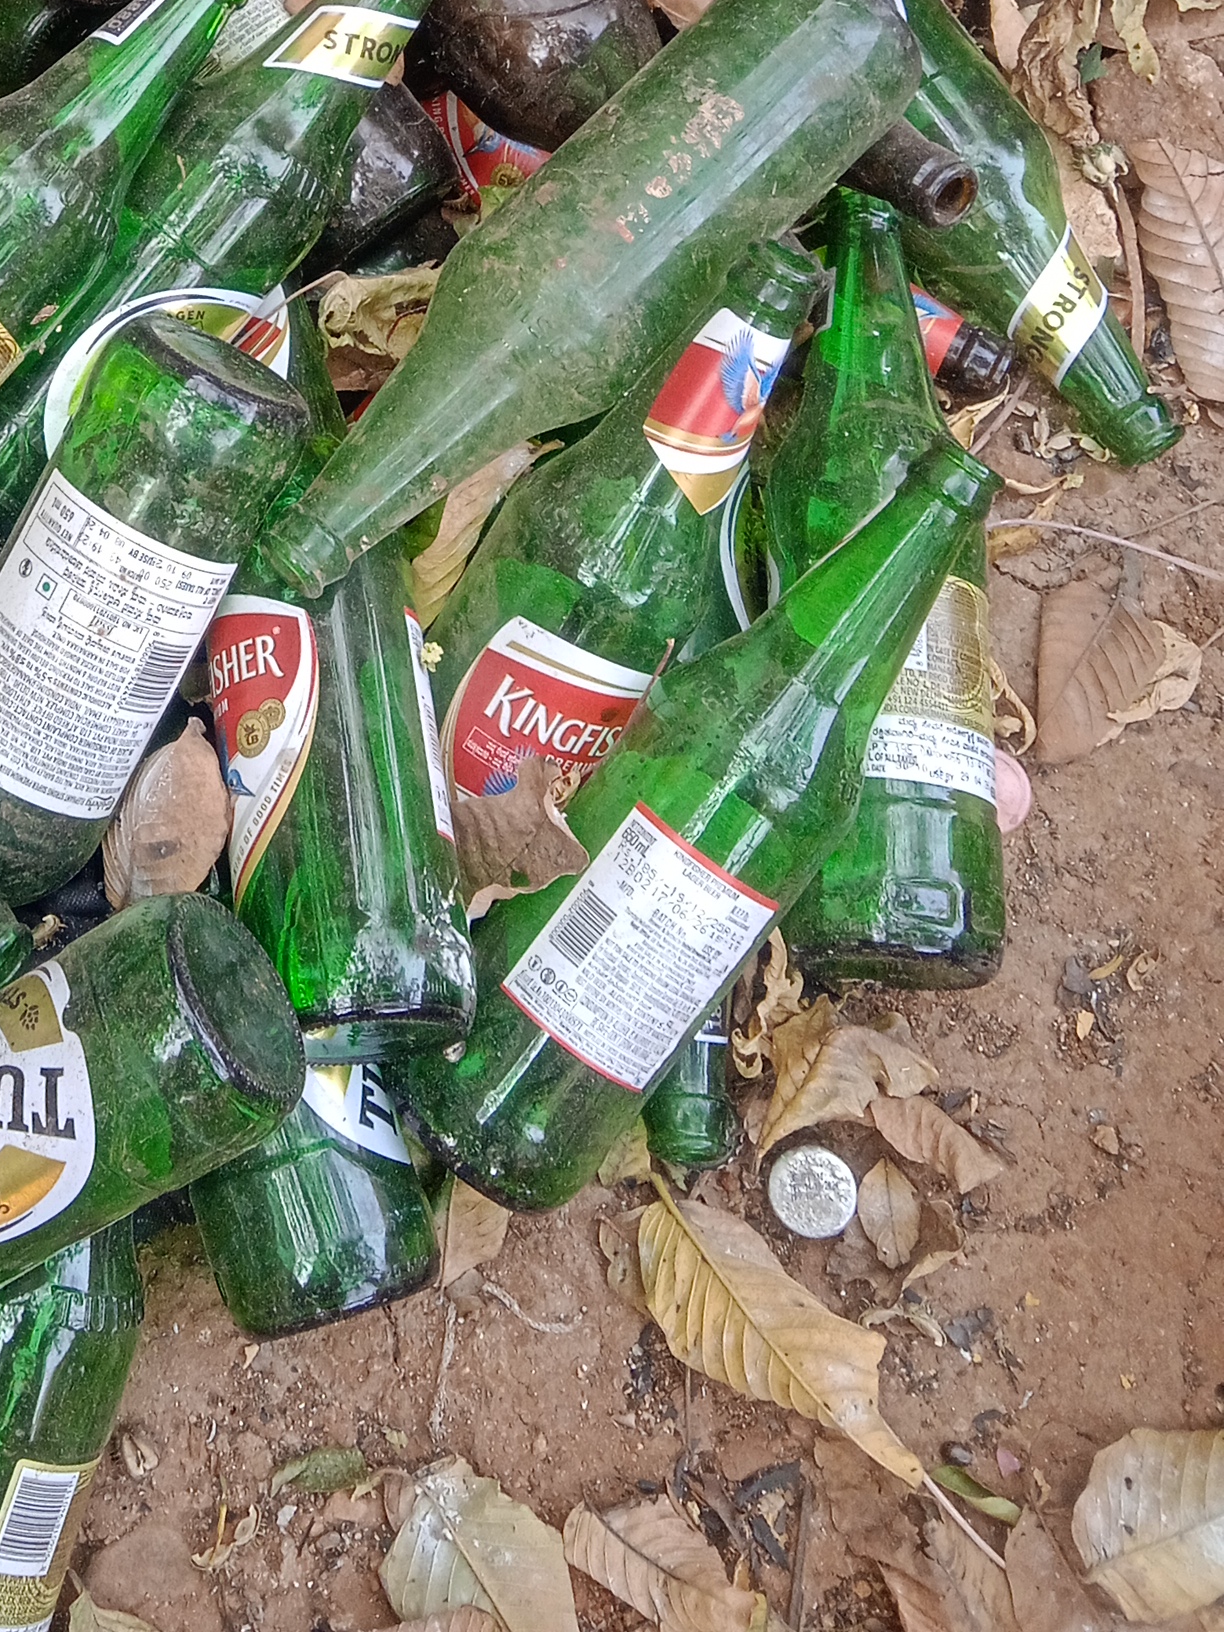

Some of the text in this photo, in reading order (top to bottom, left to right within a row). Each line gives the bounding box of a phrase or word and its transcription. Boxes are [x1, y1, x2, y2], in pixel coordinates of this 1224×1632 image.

[1022, 266, 1092, 363] STRONG
[242, 827, 253, 843] OF
[250, 794, 273, 826] GOOD
